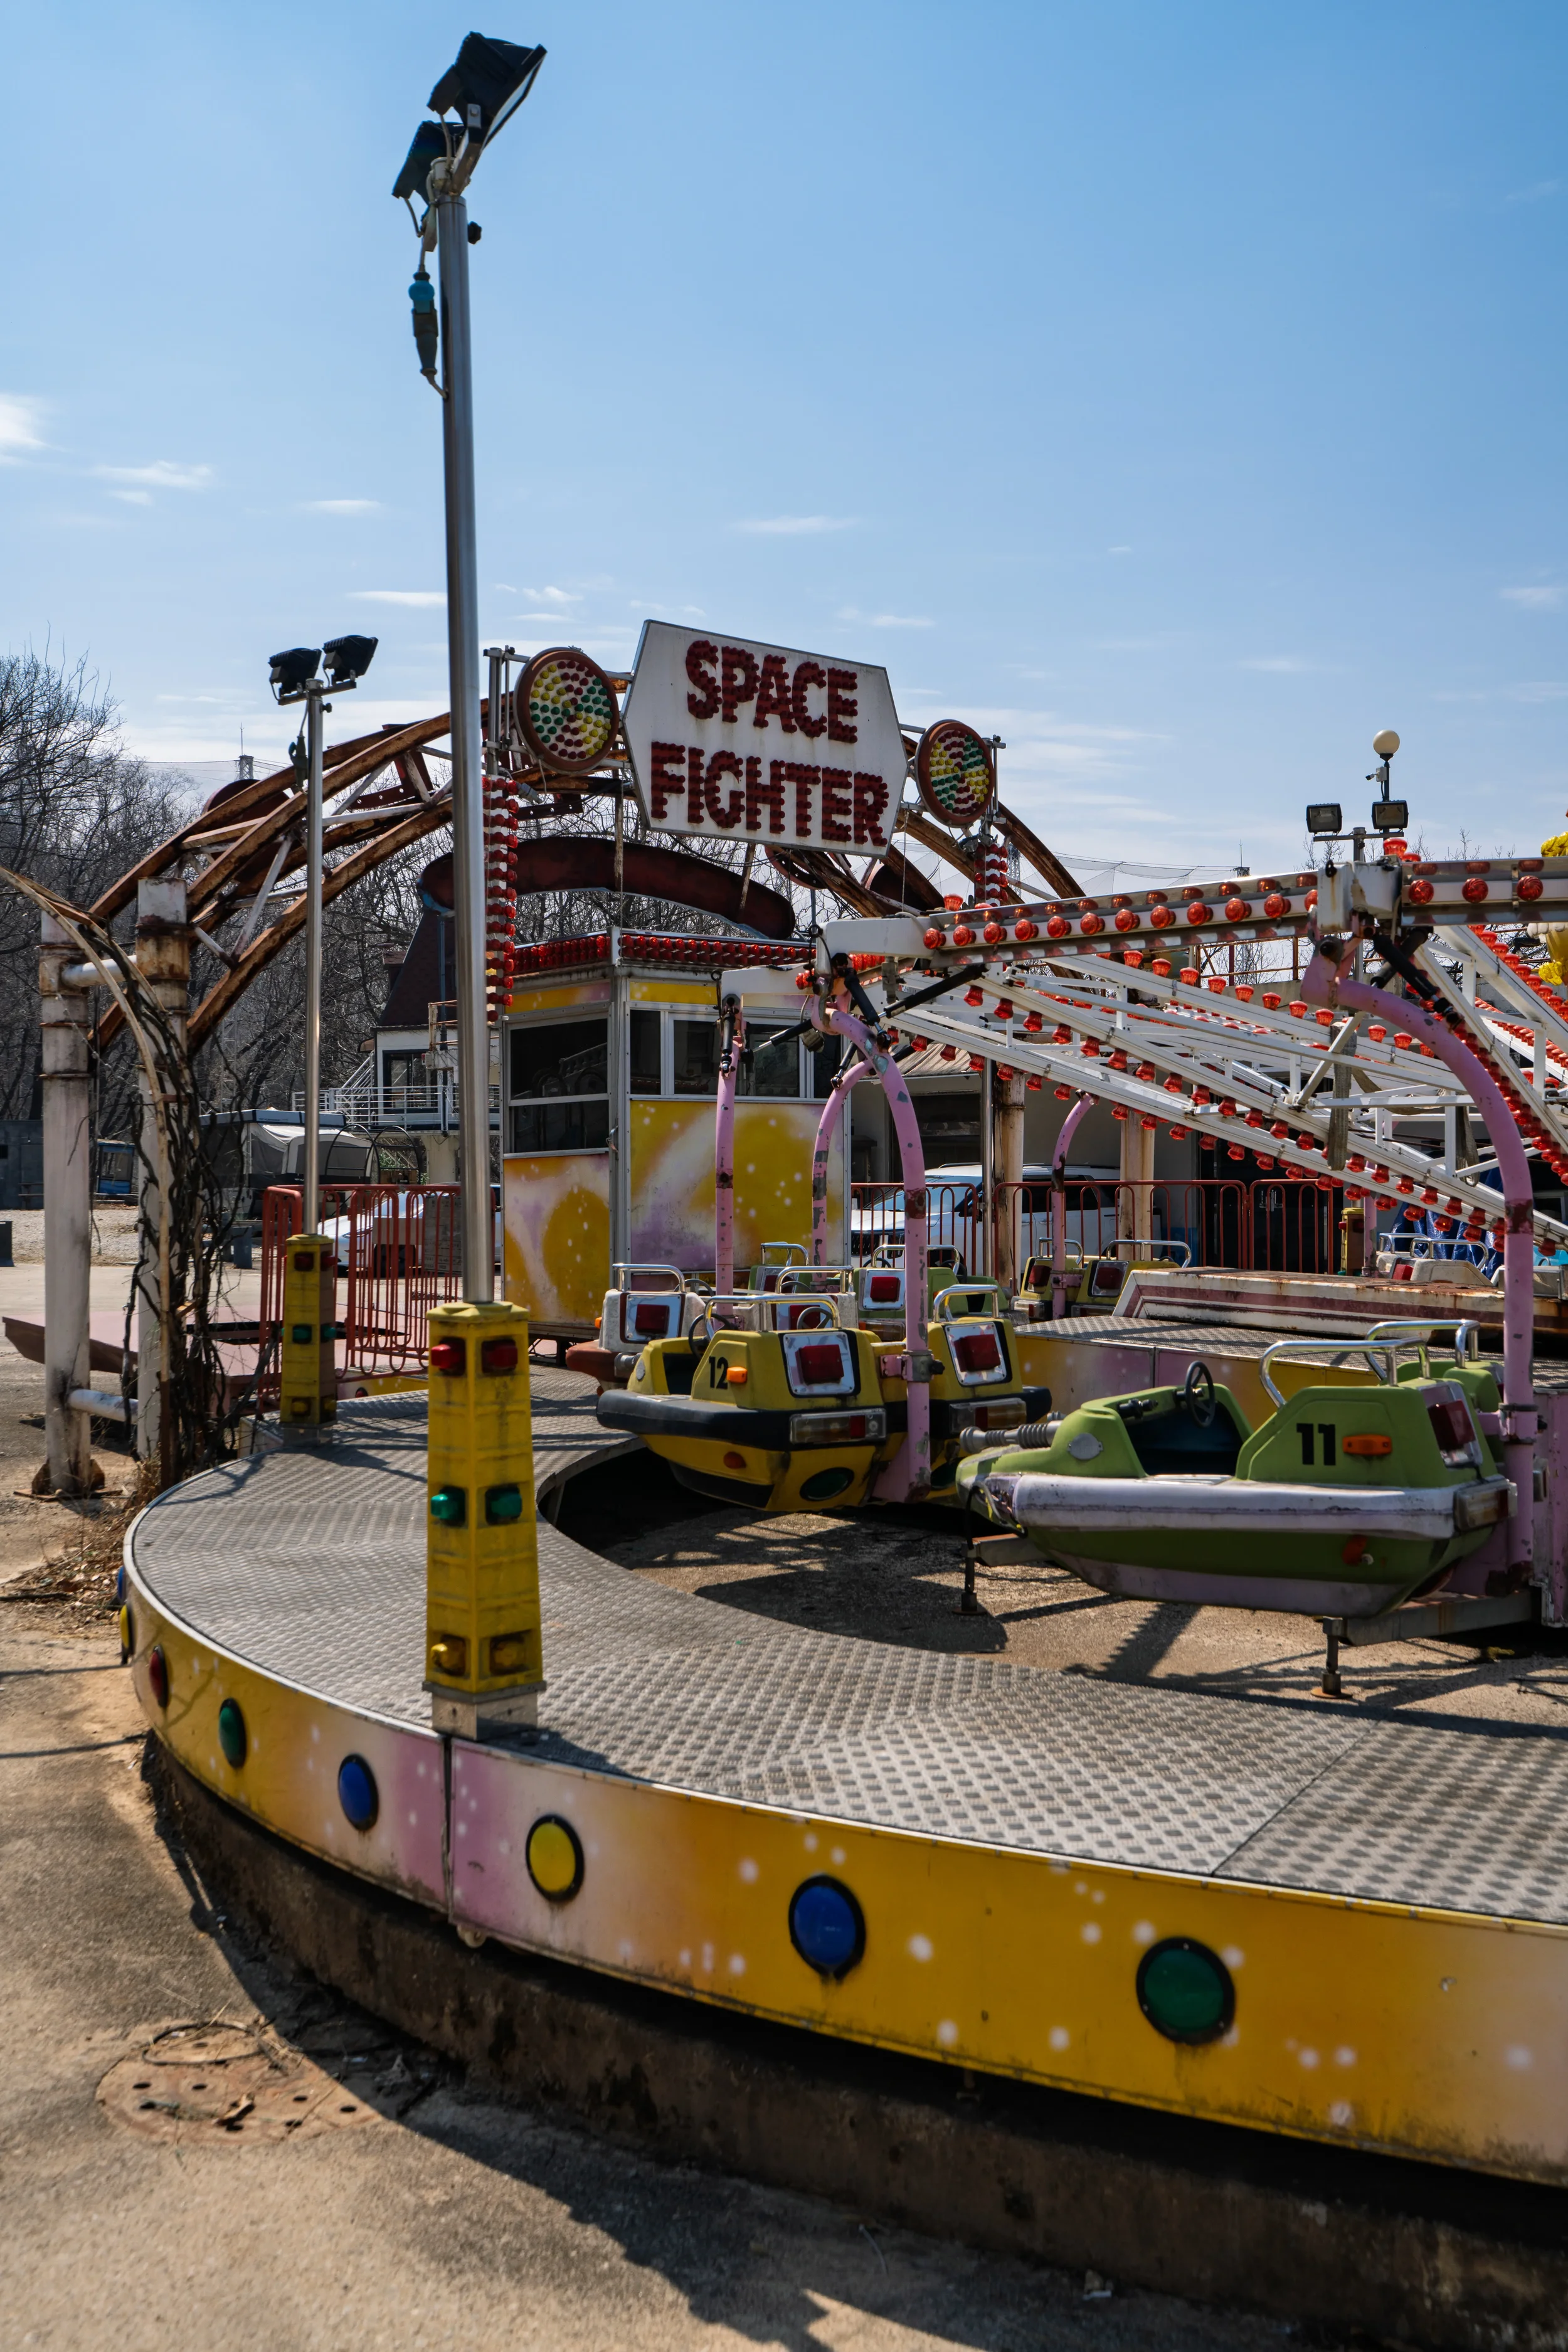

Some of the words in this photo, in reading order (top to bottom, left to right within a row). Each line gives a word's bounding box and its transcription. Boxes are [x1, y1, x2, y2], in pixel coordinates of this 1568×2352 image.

[686, 640, 857, 743] SPACE
[651, 741, 889, 847] FIGHTER
[709, 1356, 729, 1389] 12
[1296, 1423, 1336, 1466] 11
